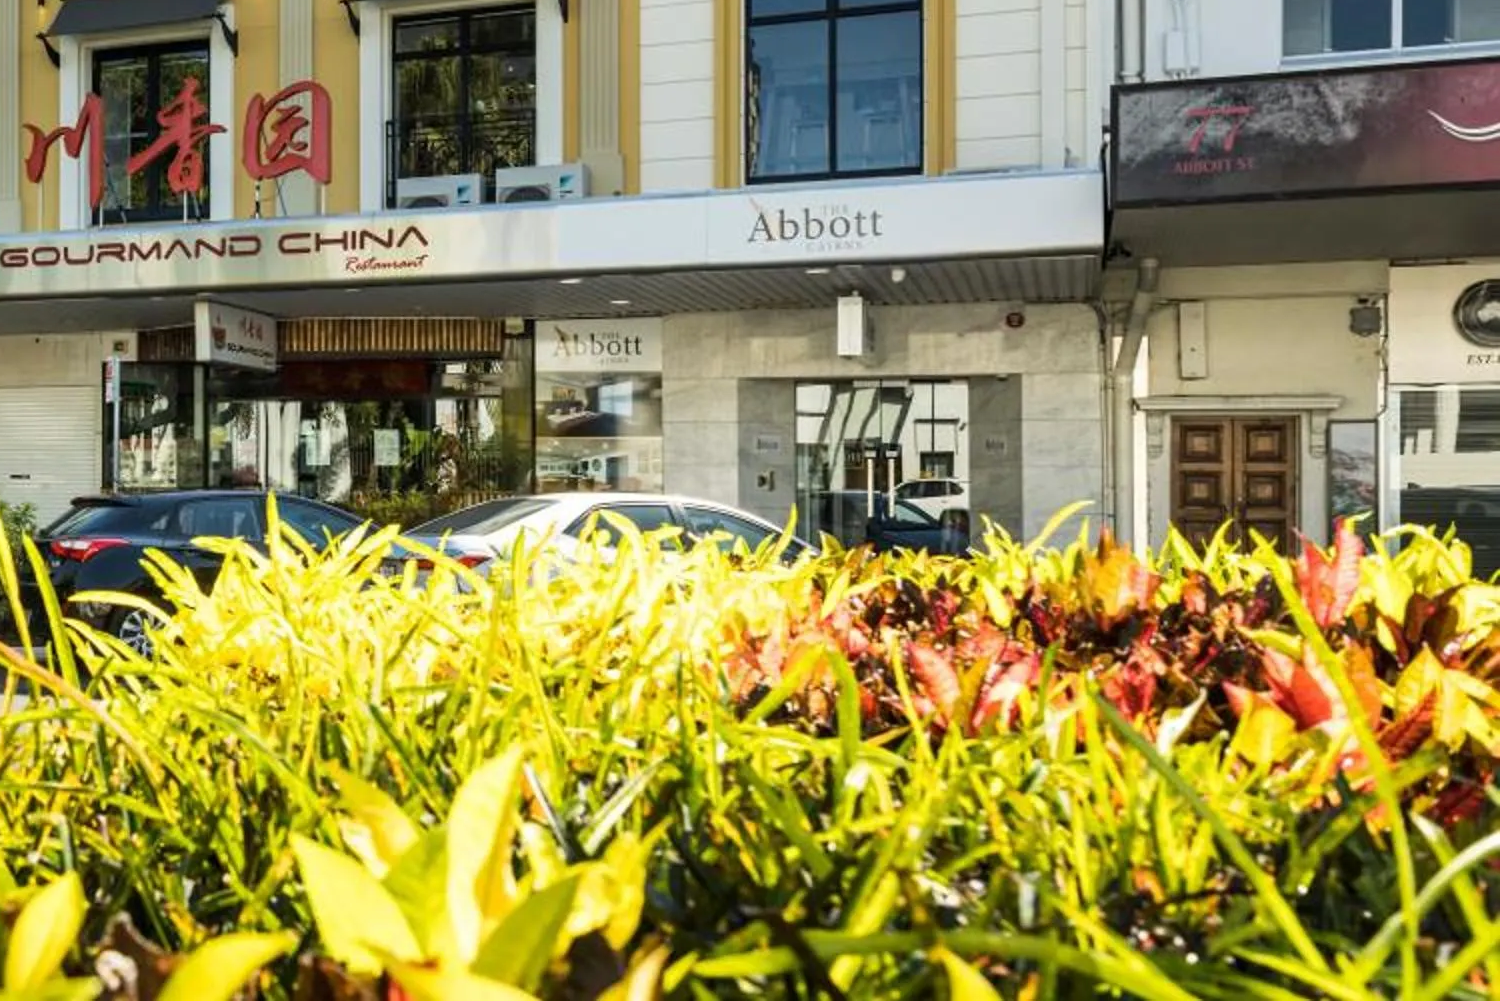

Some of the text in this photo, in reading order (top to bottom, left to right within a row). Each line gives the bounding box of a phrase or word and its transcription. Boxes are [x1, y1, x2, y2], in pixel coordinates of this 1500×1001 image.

[23, 76, 332, 212] 川香园
[1185, 105, 1255, 154] 77
[748, 208, 883, 242] Abbott
[0, 226, 429, 268] GOURMAND CHINA
[346, 255, 429, 273] Restaurant
[553, 331, 643, 357] Abbott
